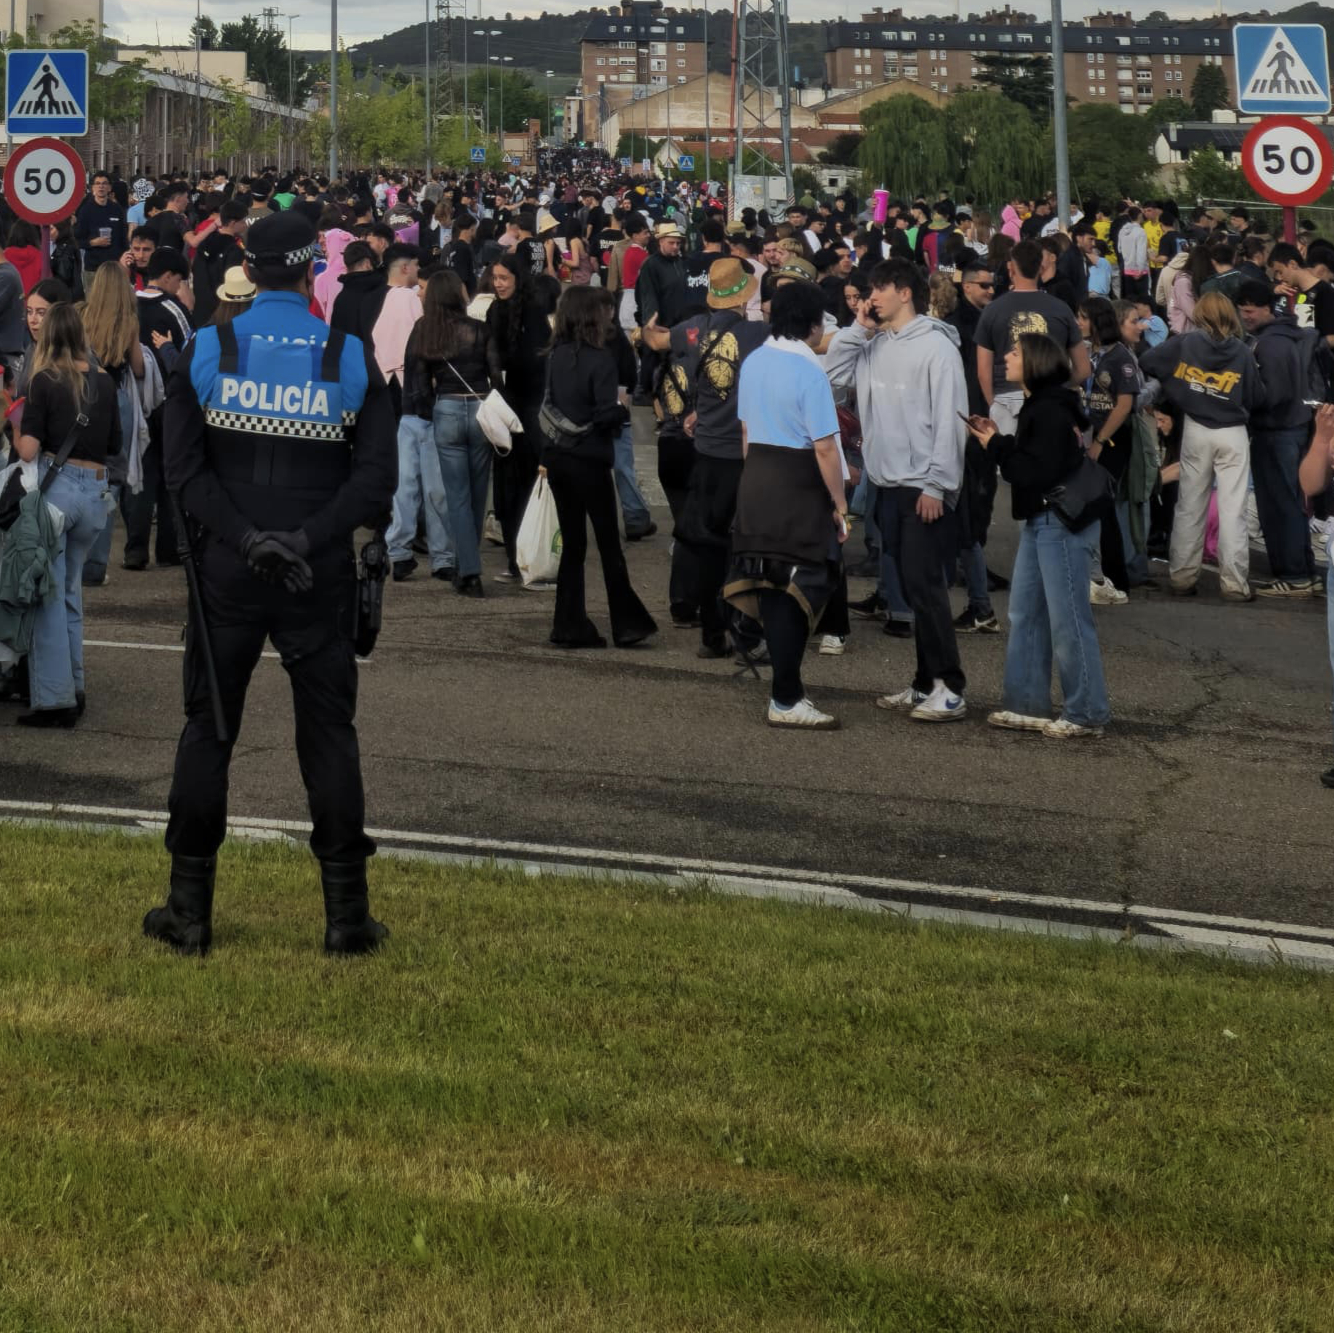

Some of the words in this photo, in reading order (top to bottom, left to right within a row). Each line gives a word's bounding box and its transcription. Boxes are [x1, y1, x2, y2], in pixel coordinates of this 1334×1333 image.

[1262, 144, 1315, 176] 50
[24, 168, 66, 196] 50
[221, 377, 329, 417] POLICÍA
